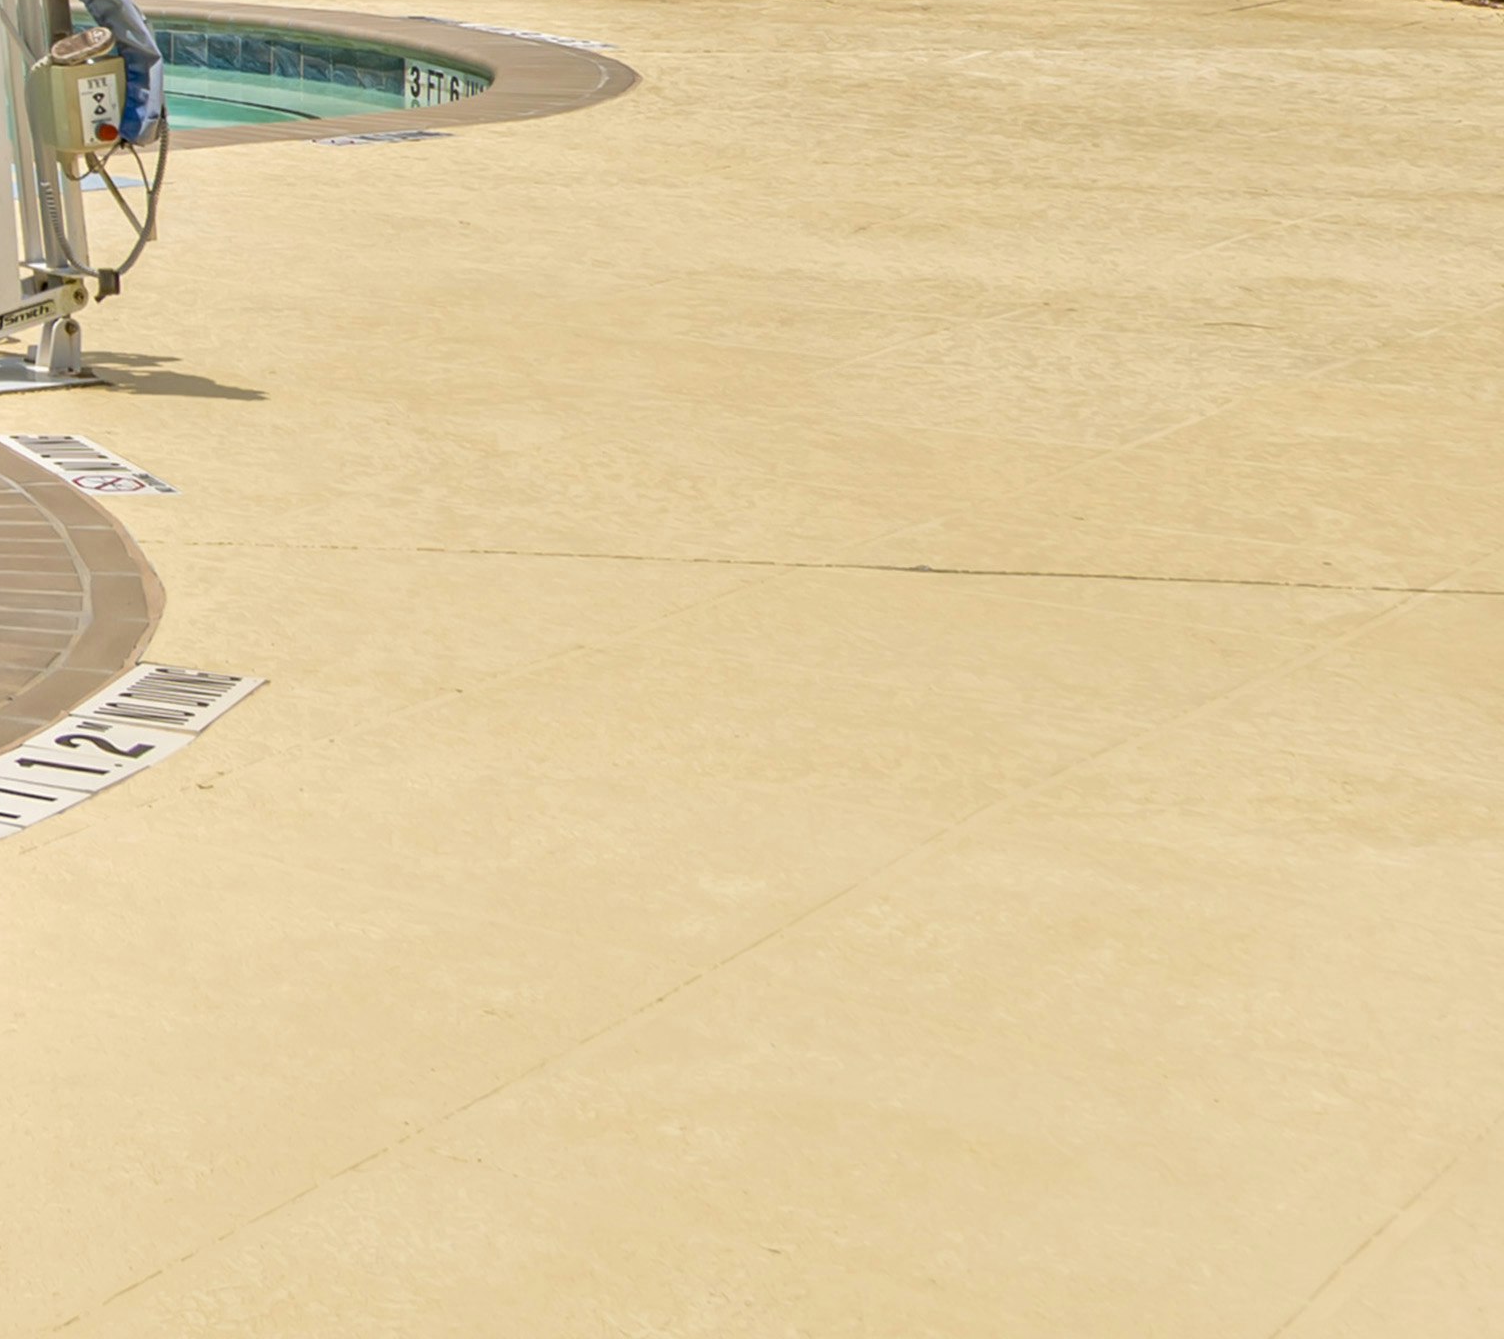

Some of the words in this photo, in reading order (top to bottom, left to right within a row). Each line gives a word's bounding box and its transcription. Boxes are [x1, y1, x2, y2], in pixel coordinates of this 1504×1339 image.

[410, 66, 420, 98] 3
[427, 69, 444, 105] FT
[450, 76, 459, 102] 6
